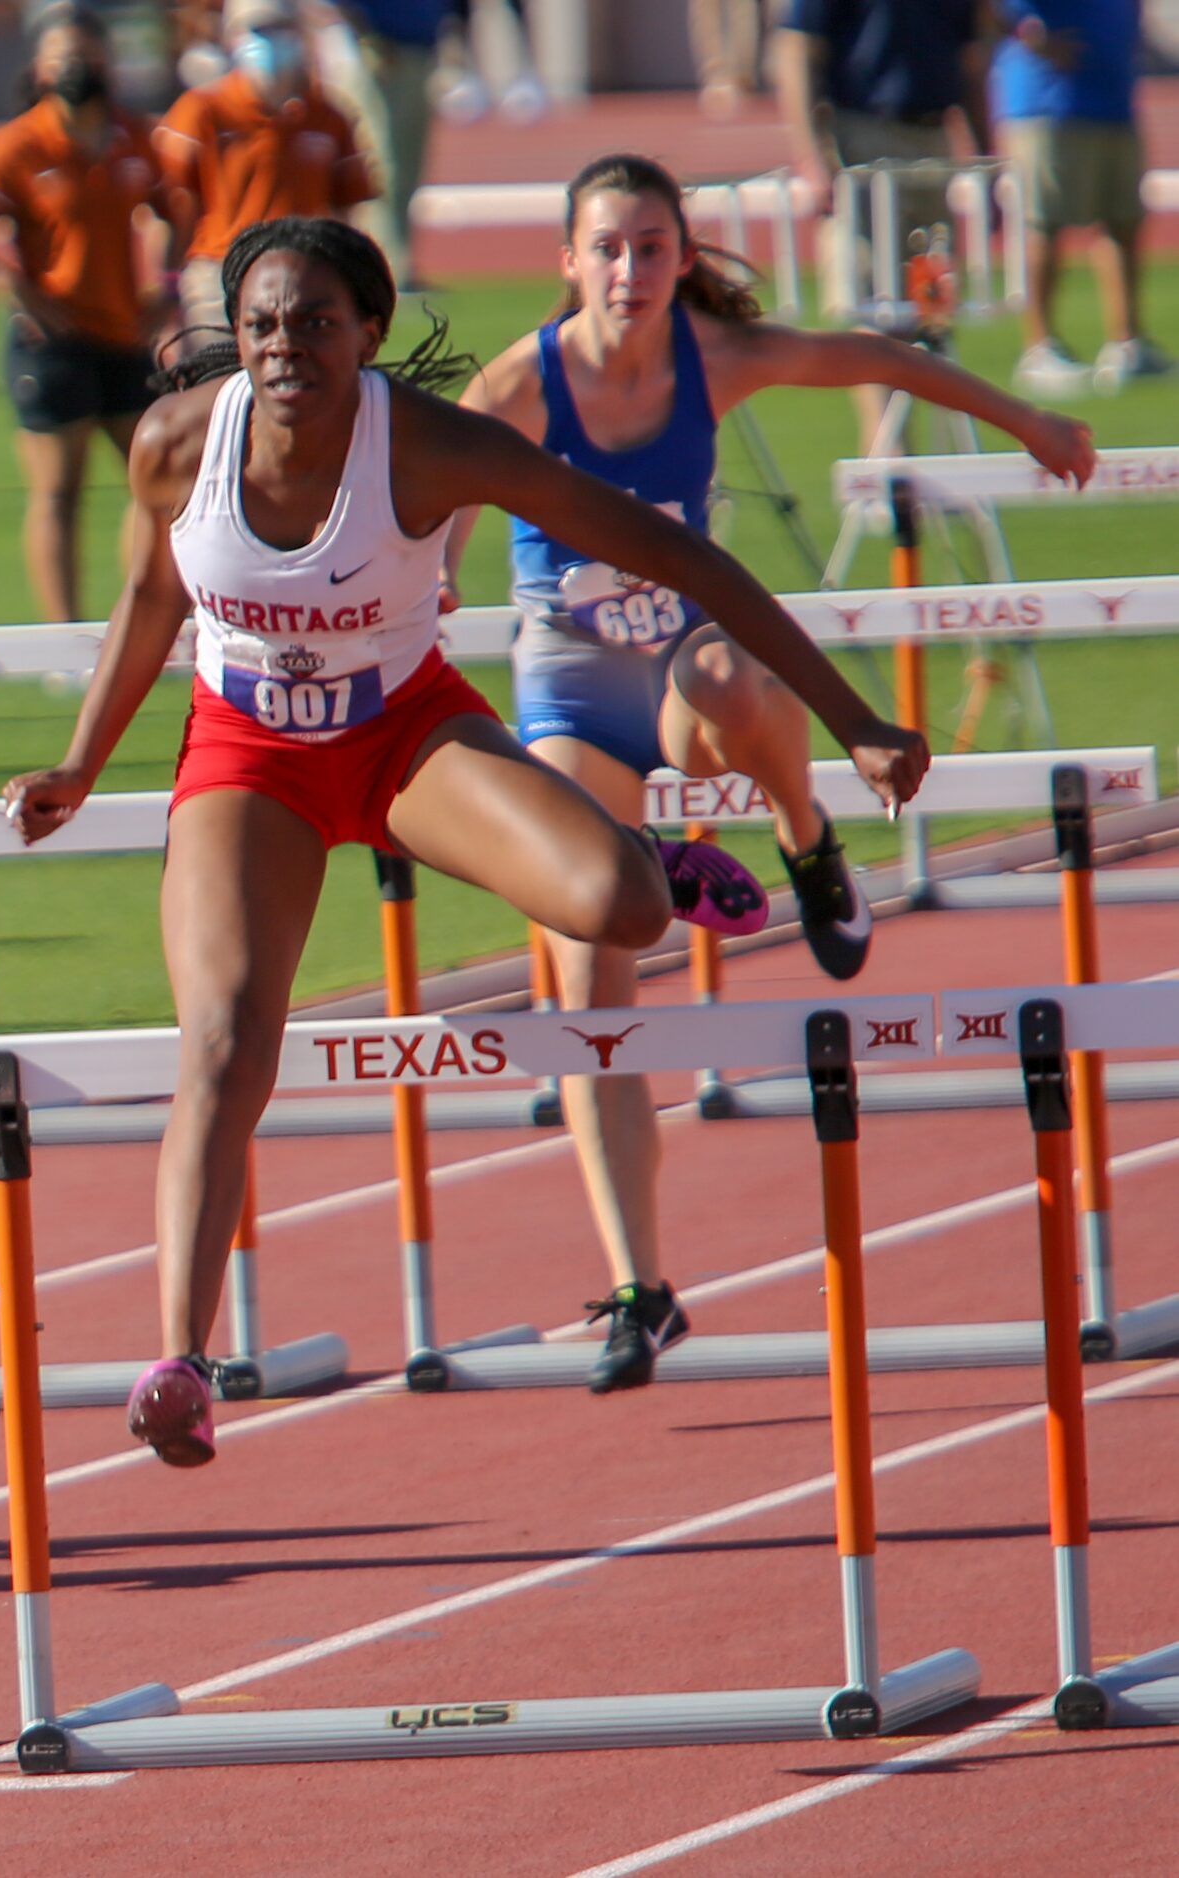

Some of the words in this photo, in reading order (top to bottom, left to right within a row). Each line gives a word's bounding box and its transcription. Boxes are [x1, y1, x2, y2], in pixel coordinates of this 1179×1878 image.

[197, 584, 384, 633] HERITAGE
[595, 586, 685, 645] 693
[911, 592, 1045, 632] TEXAS
[254, 676, 352, 729] 907
[647, 779, 775, 818] TEXA
[314, 1029, 507, 1081] TEXAS
